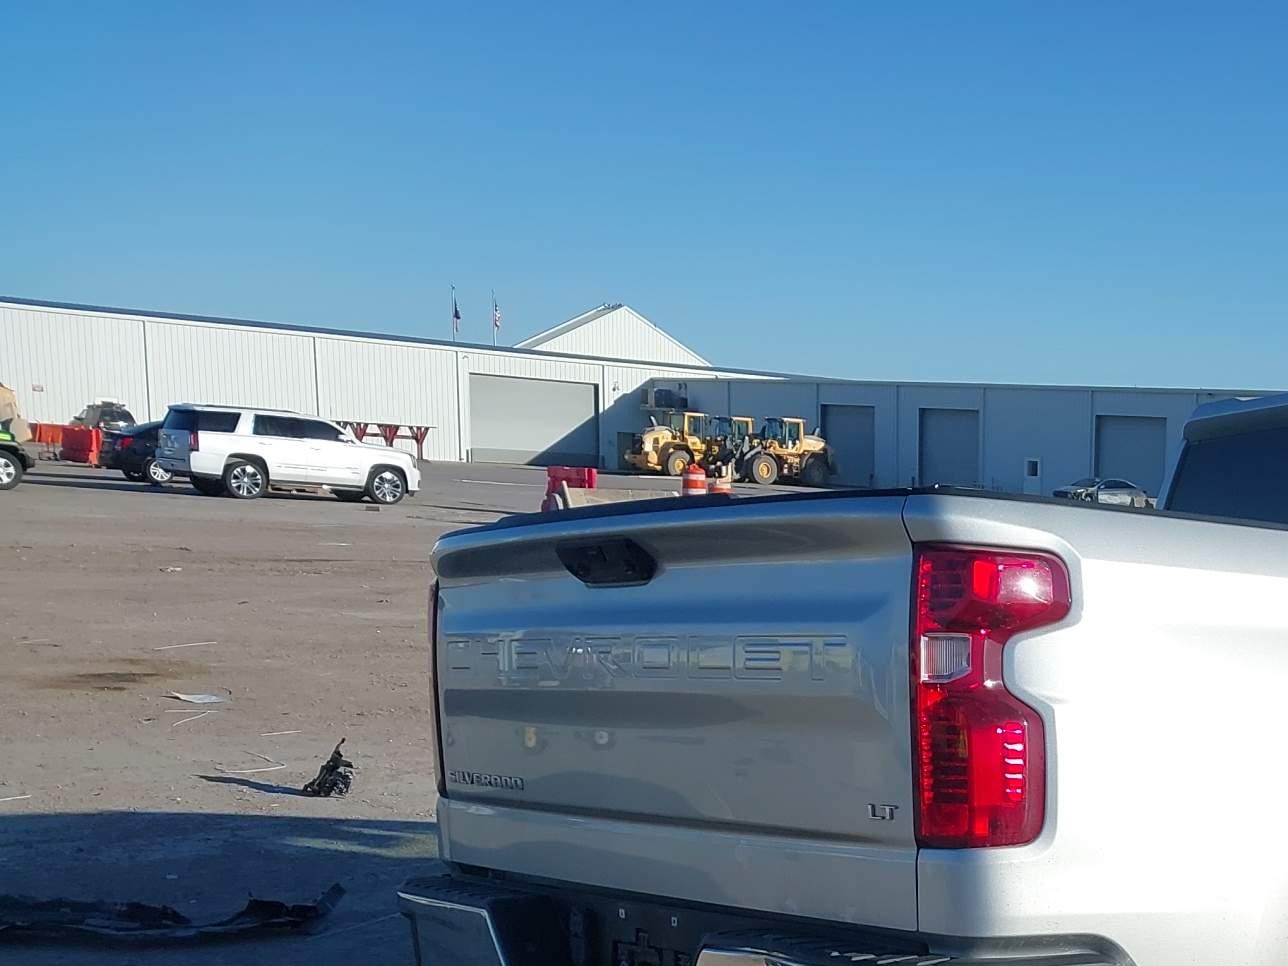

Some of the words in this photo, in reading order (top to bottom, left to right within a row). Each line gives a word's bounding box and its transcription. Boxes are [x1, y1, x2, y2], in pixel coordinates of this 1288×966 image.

[446, 634, 849, 682] CHEVROLET
[448, 770, 525, 790] SILVERADO
[868, 803, 899, 820] LT
